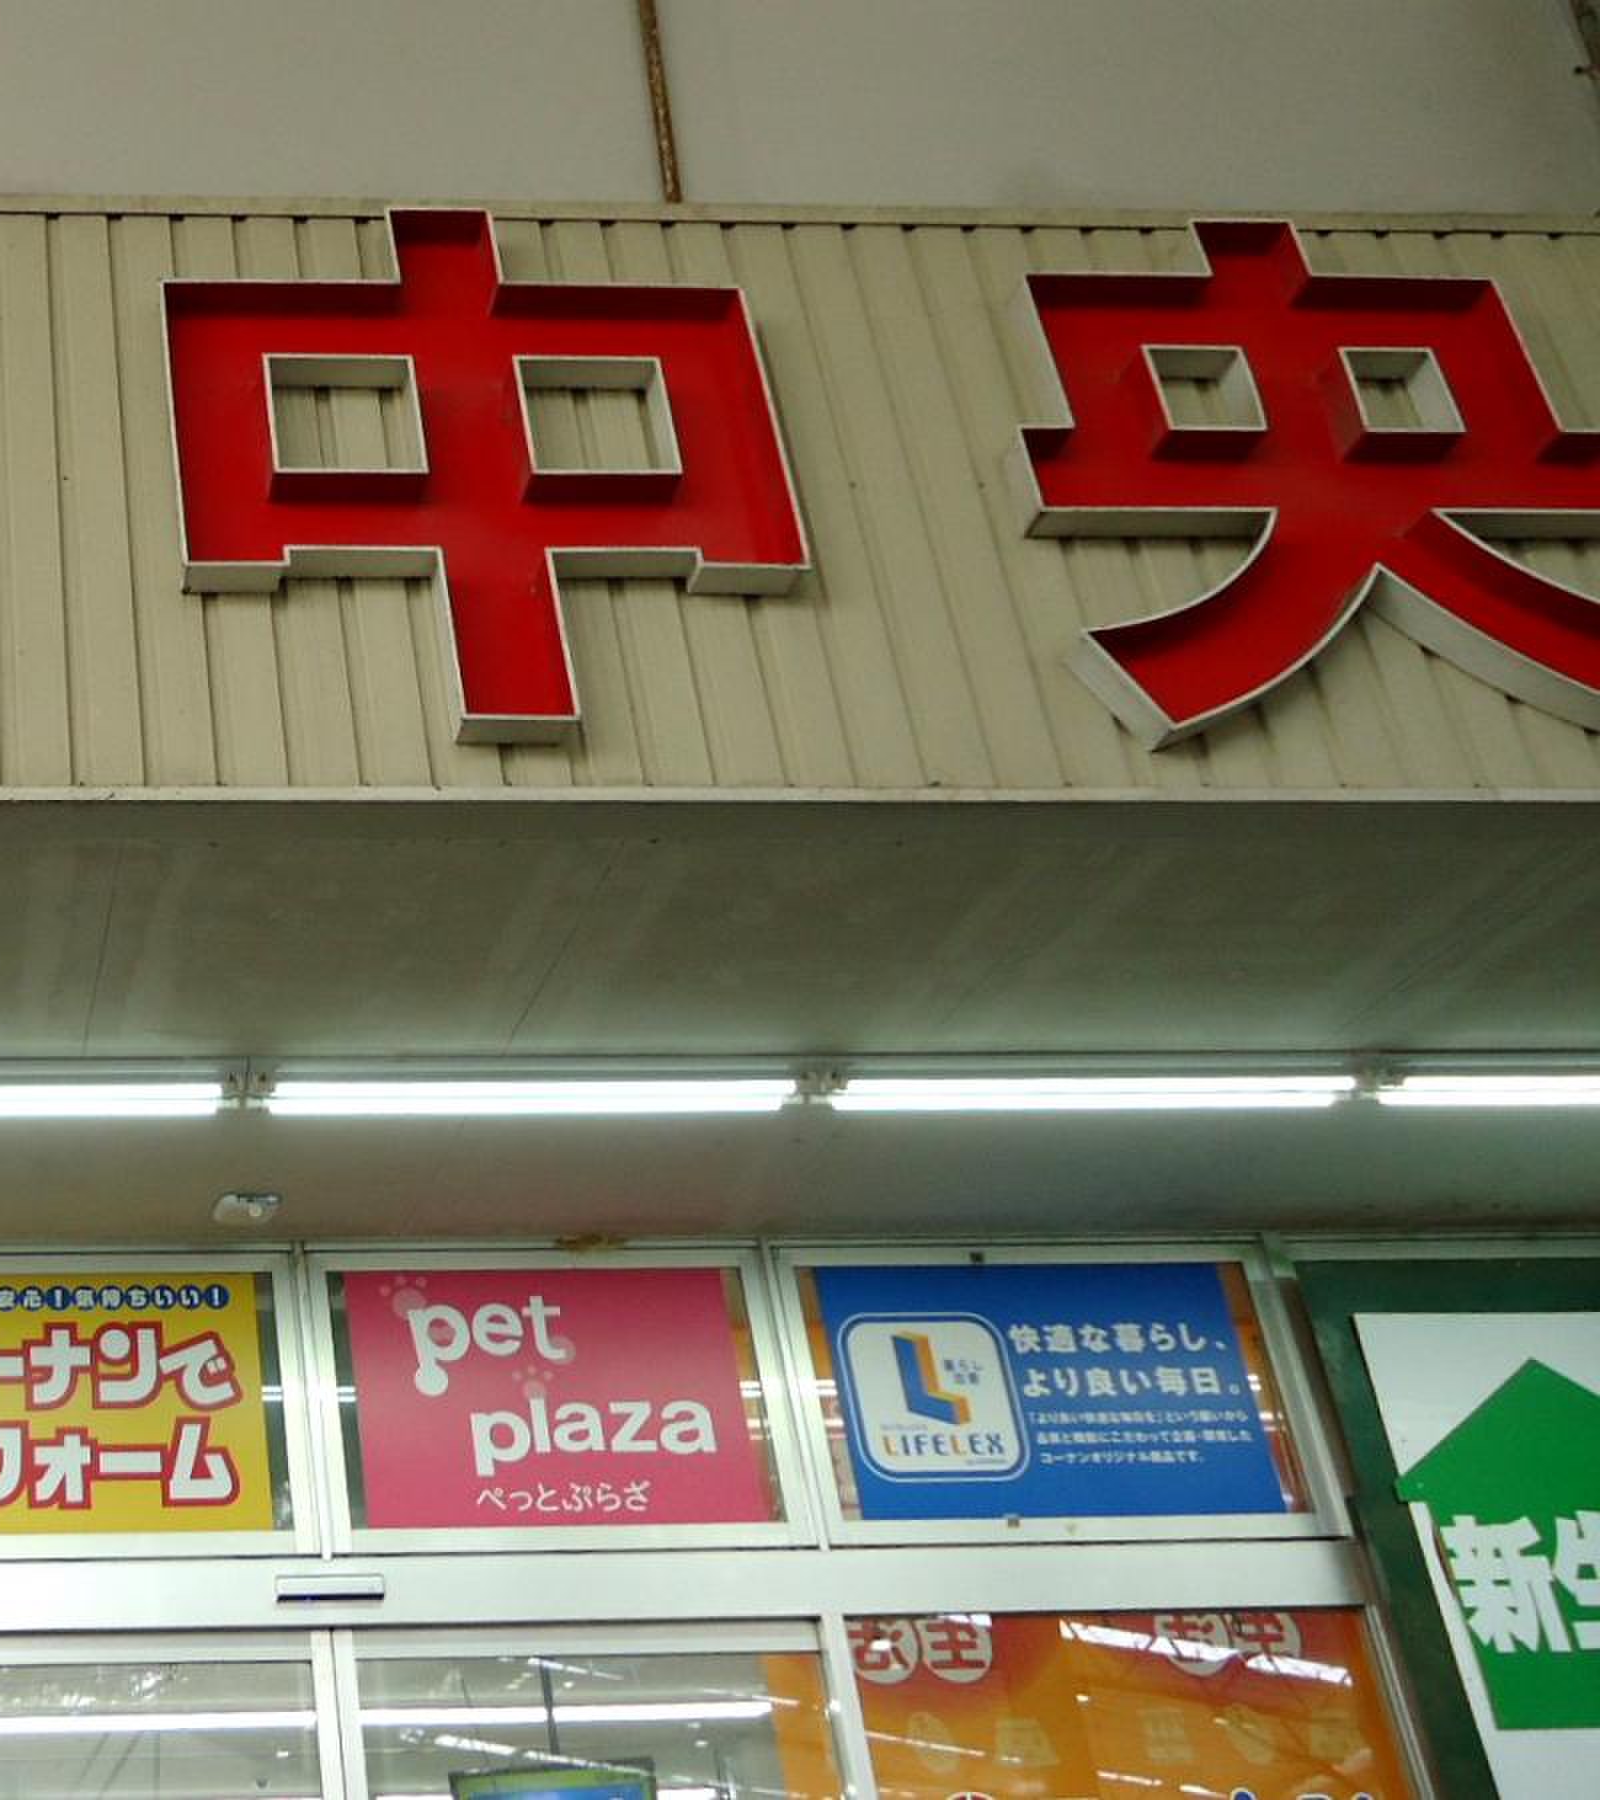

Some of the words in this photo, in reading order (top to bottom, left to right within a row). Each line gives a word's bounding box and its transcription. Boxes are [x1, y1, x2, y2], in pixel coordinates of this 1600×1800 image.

[406, 1294, 568, 1397] pet
[1007, 1322, 1228, 1355] 快適な暮らし、
[1021, 1366, 1241, 1399] より良い毎日。
[470, 1397, 718, 1477] plaza
[881, 1432, 1004, 1457] LIFELEX
[475, 1480, 652, 1514] ぺっとぷらざ
